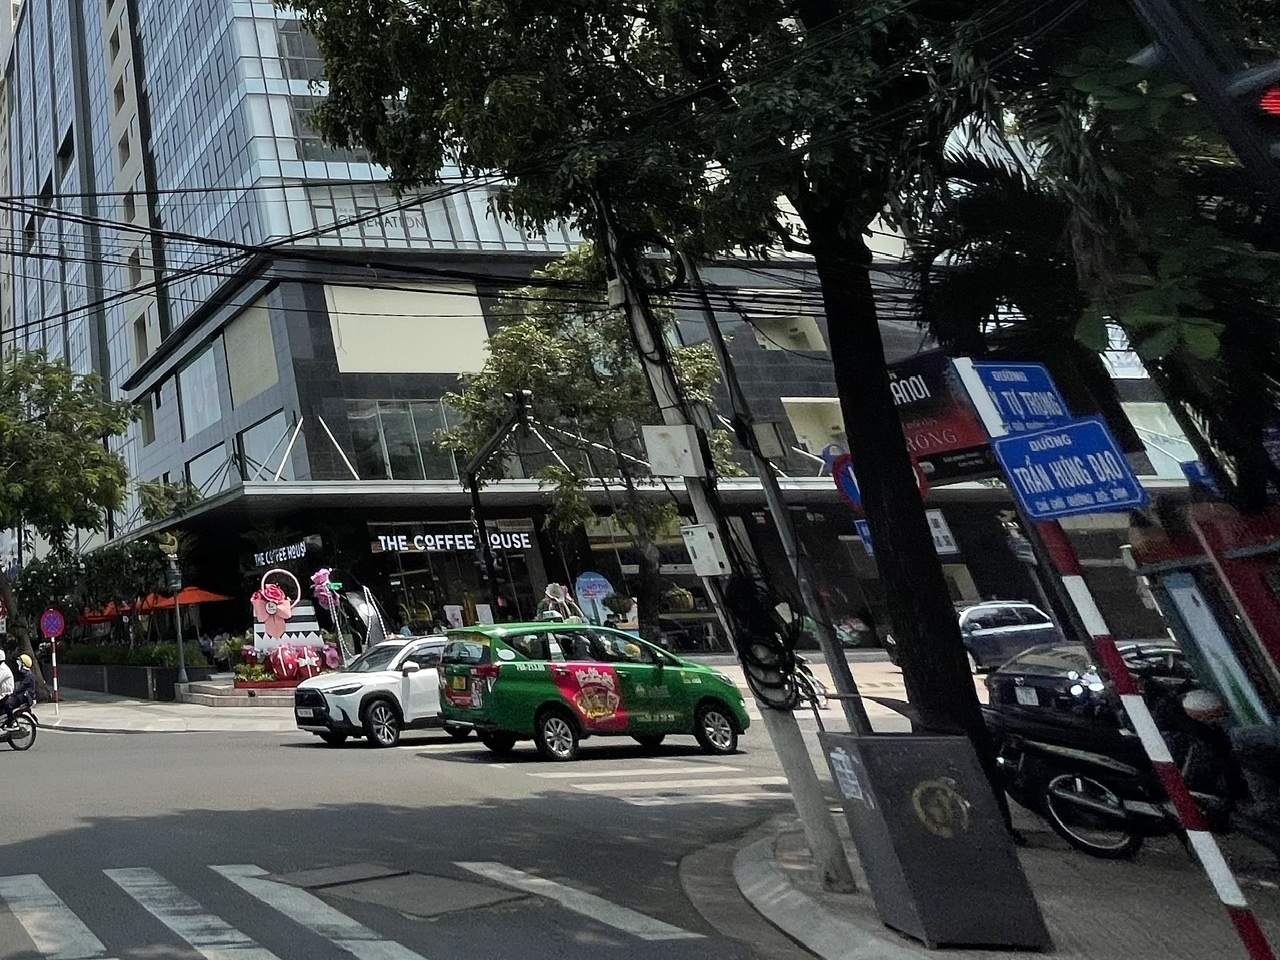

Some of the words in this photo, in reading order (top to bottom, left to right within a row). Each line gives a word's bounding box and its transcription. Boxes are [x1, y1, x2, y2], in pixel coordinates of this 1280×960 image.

[1085, 450, 1124, 486] ĐẠO
[378, 535, 409, 551] THE
[413, 534, 476, 551] COFFEE
